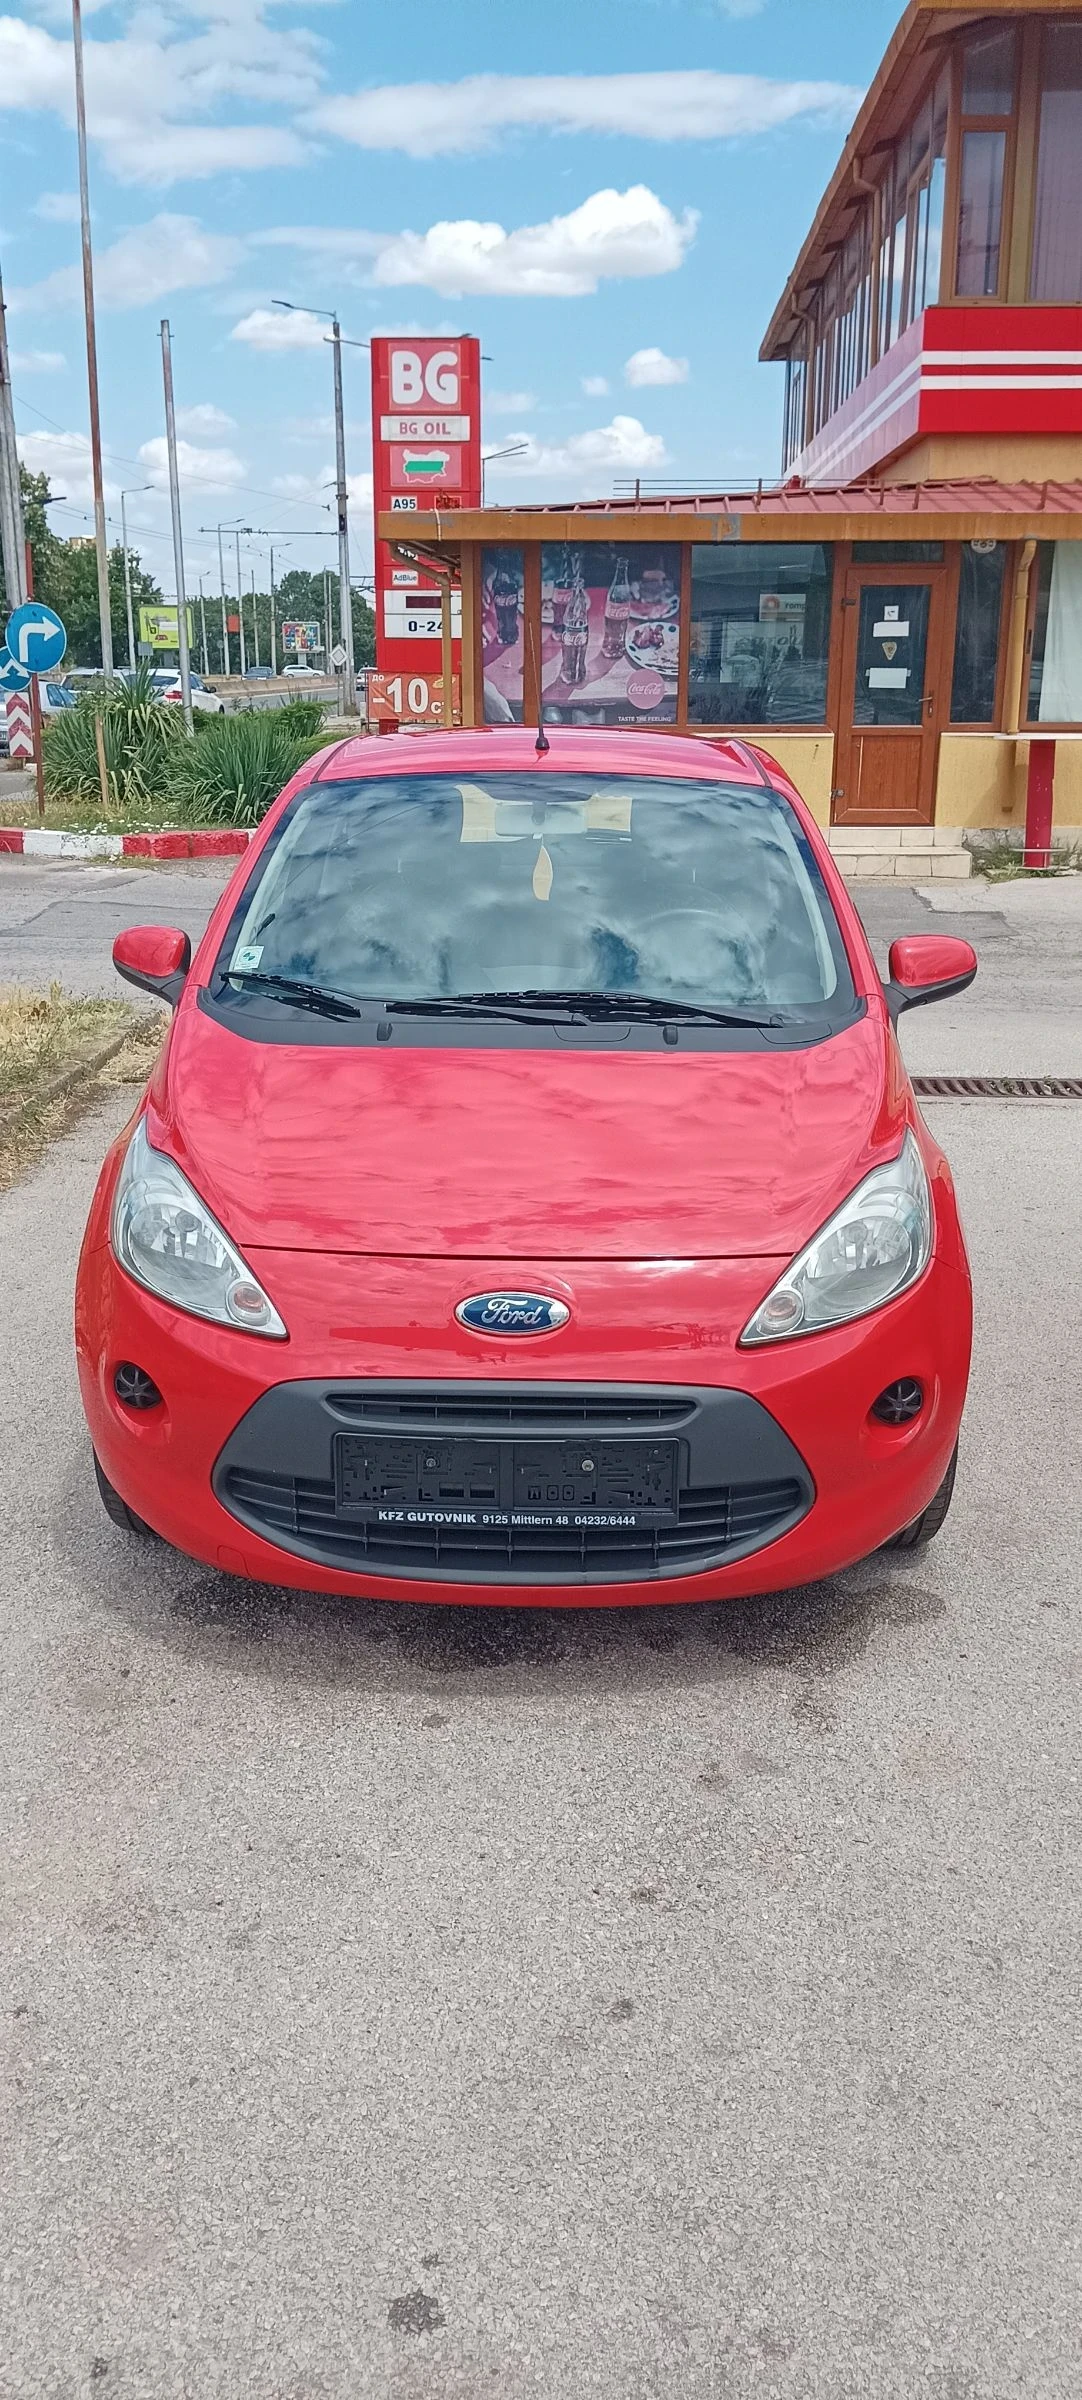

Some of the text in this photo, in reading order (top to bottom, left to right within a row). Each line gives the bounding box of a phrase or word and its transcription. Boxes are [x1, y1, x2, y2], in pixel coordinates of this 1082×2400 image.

[391, 350, 458, 405] BG
[399, 422, 451, 435] BG OIL
[393, 498, 416, 510] A95
[393, 574, 417, 582] AdBlue
[481, 1298, 543, 1325] Ford
[378, 1510, 636, 1526] KFZ GUTOVNIK 9125 Mittlern 48 04232/6444
